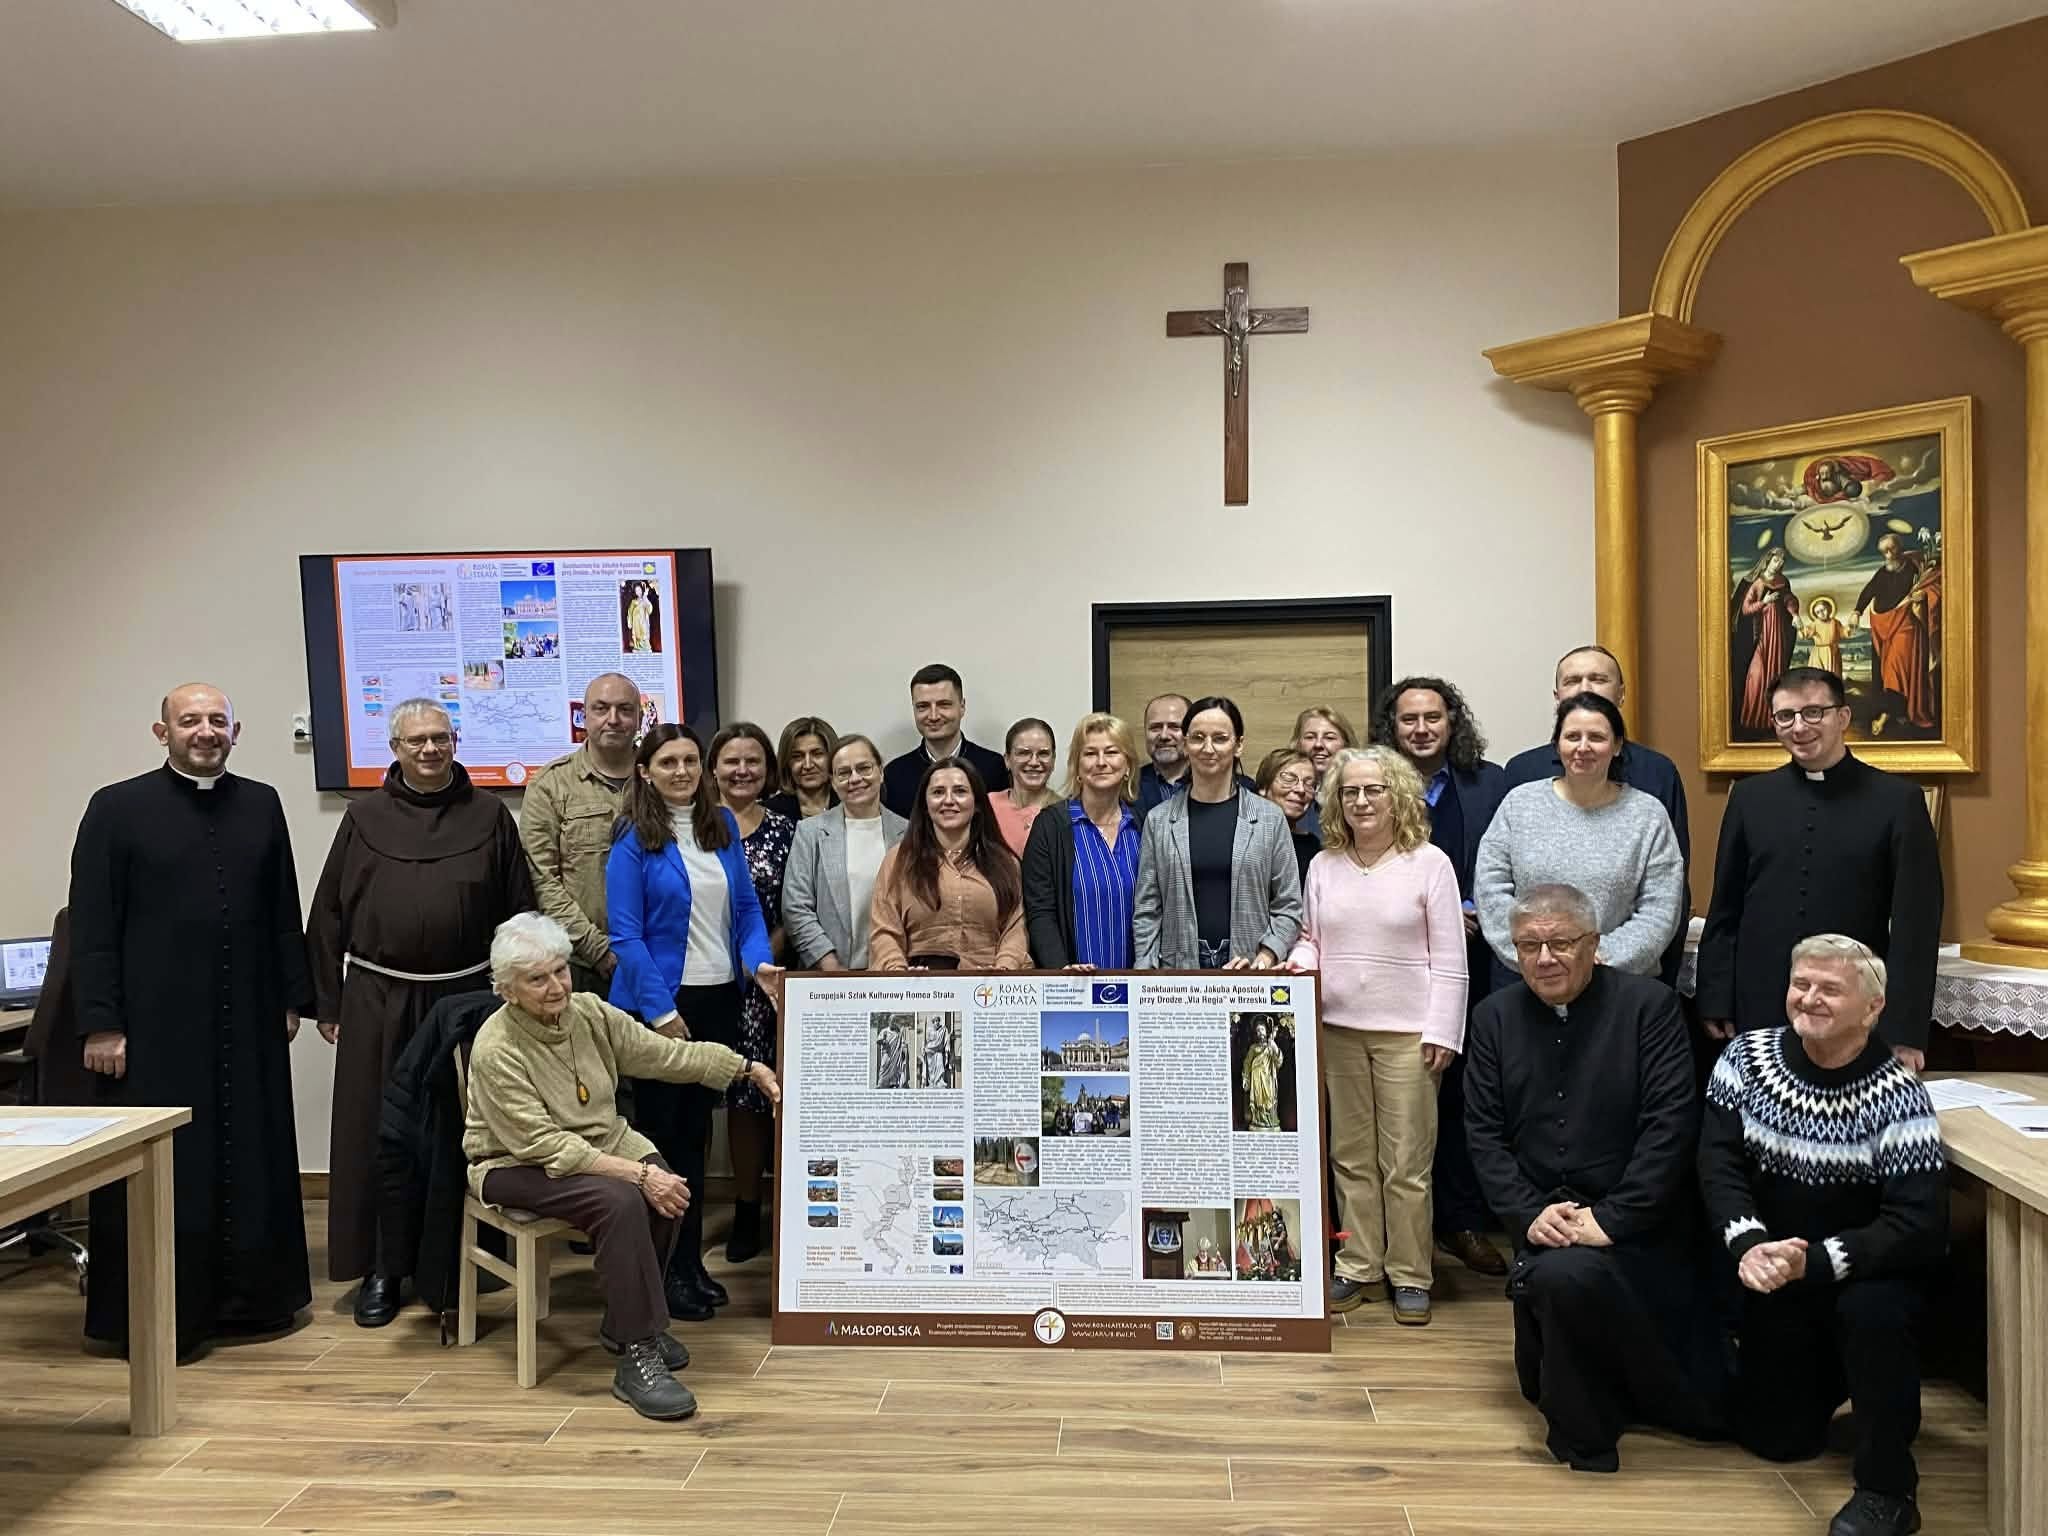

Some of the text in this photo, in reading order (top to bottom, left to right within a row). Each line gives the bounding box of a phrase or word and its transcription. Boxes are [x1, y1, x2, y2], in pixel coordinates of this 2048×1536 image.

[1000, 983, 1037, 994] ROMEA
[1141, 985, 1188, 993] Sanktuarium
[1204, 985, 1230, 993] Jakuba
[1232, 985, 1265, 994] Apostoła
[809, 990, 955, 1001] Europejski Szlak Kulturowy Romea Strata
[999, 995, 1037, 1006] STRATA
[1139, 997, 1155, 1005] przy
[1157, 996, 1183, 1004] Drodze
[1238, 996, 1267, 1004] Brzesku
[841, 1324, 921, 1337] MAŁOPOLSKA
